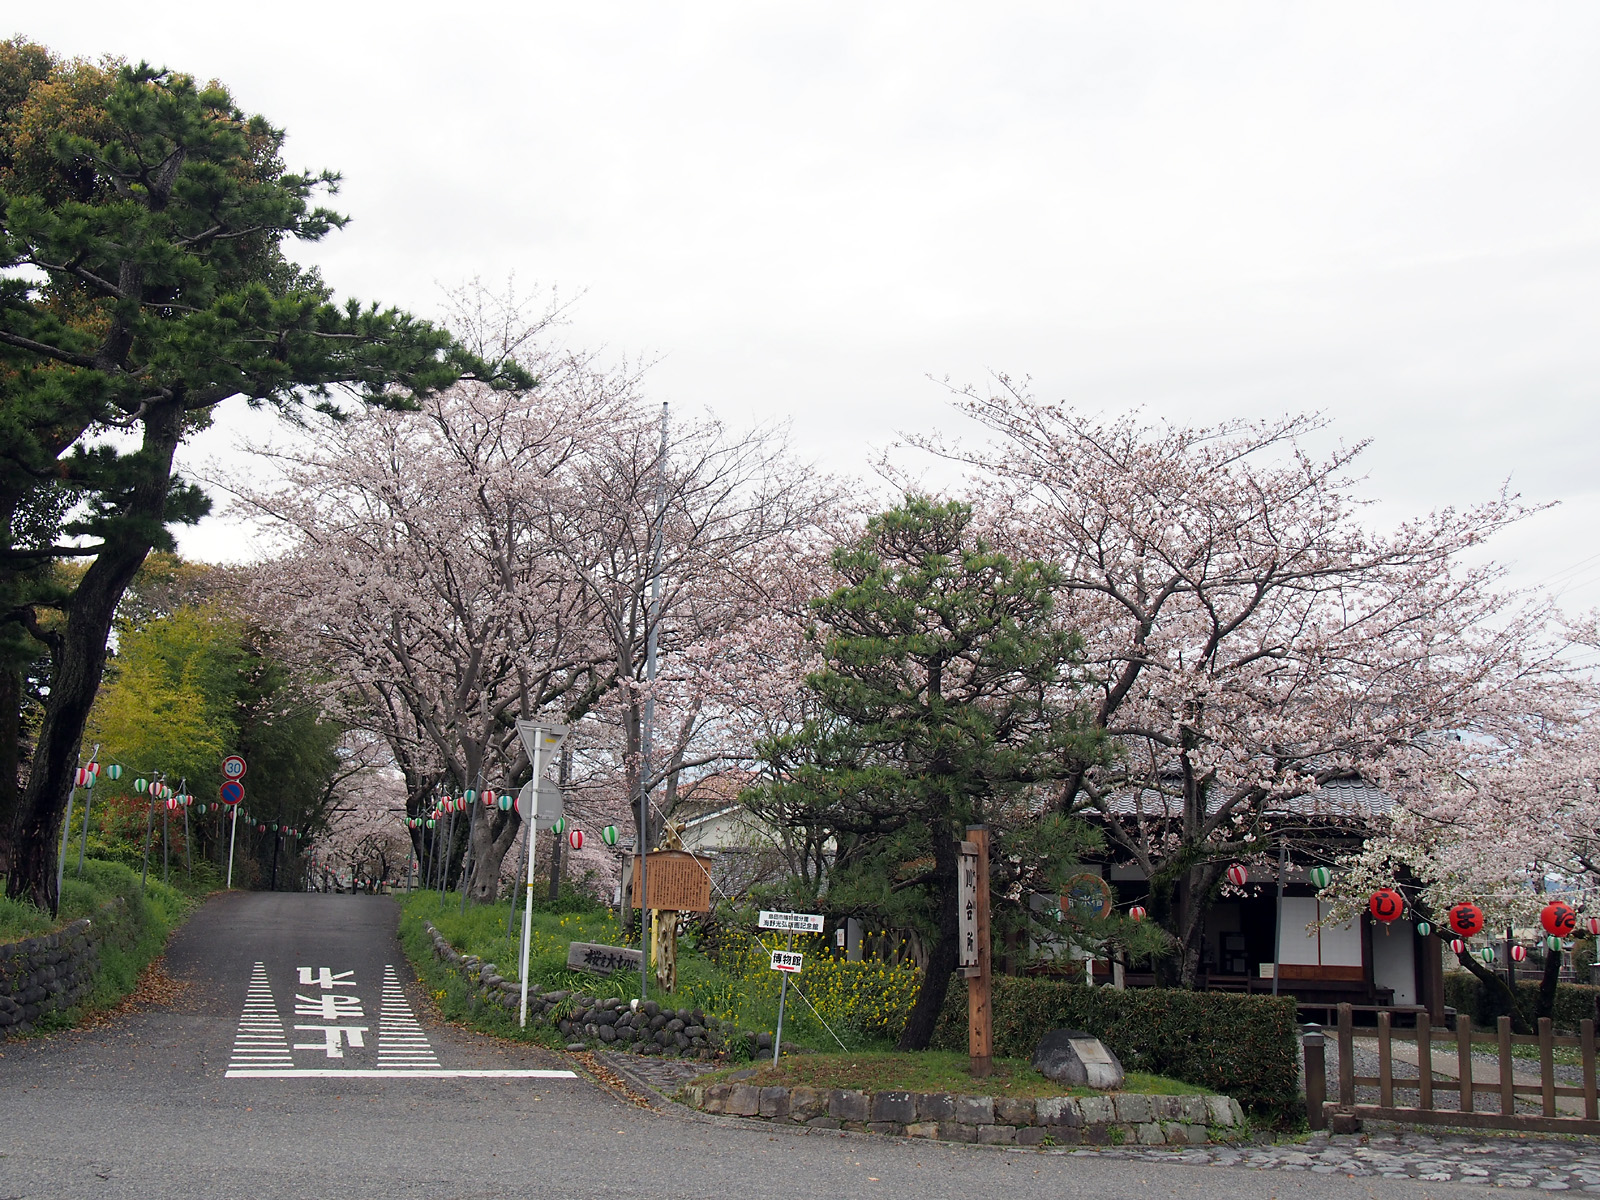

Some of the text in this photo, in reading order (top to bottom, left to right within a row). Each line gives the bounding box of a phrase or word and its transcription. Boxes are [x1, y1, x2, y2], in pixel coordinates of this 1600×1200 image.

[226, 762, 241, 774] 30
[773, 952, 802, 967] 博物館
[293, 966, 369, 1058] 止まれ
